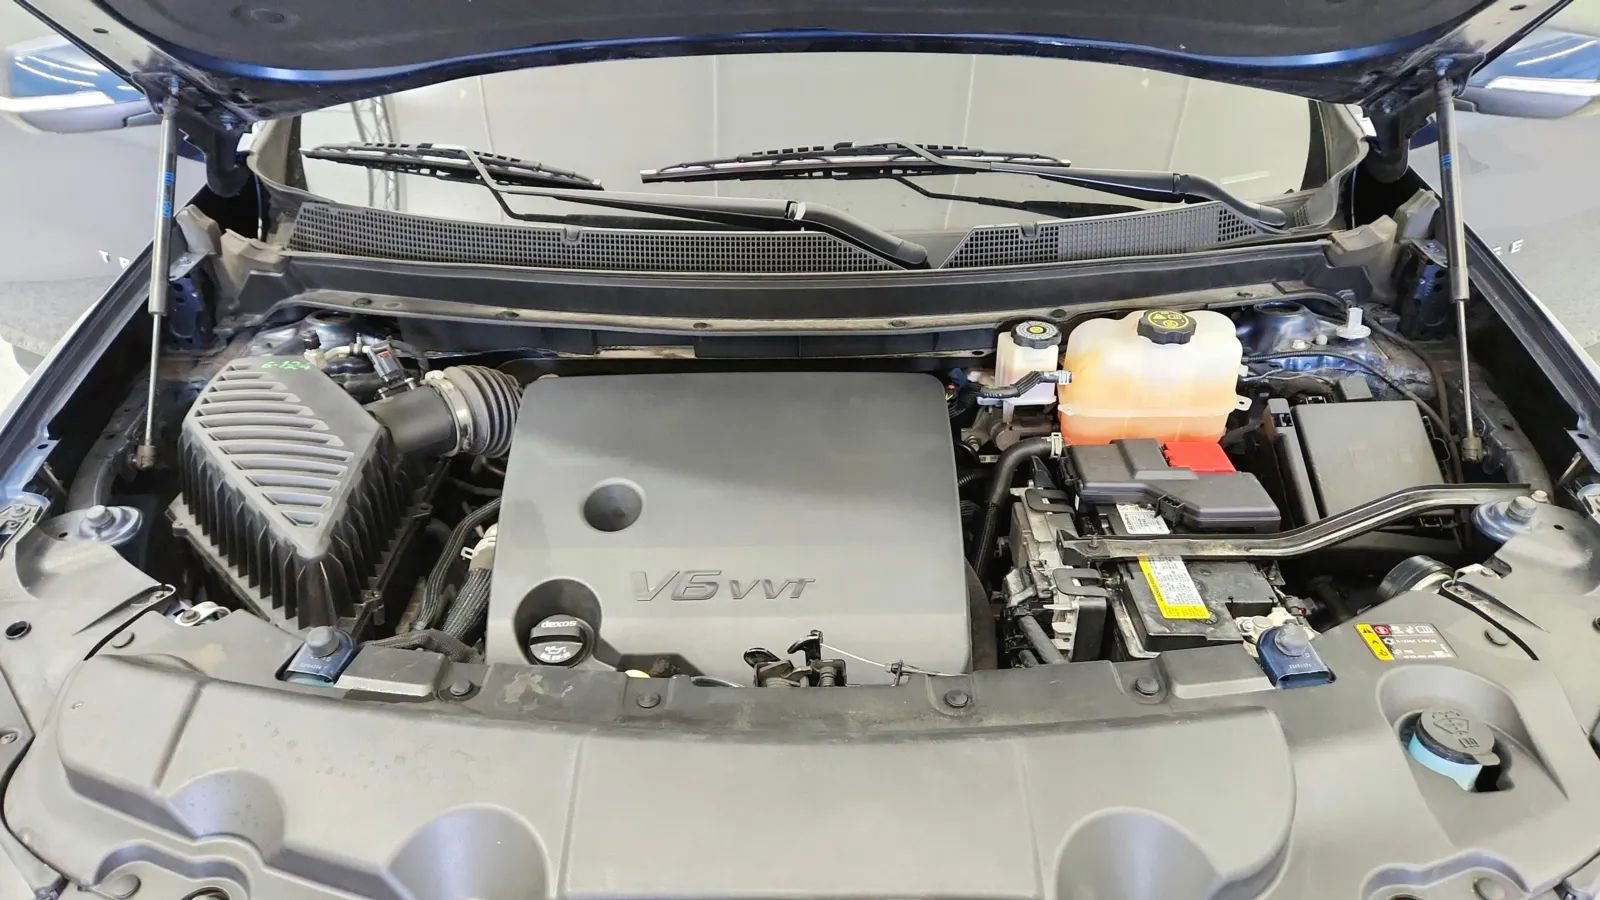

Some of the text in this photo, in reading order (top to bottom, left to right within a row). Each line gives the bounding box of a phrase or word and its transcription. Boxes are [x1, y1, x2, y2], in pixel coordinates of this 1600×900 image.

[630, 569, 817, 602] V6 VVT
[541, 620, 578, 629] dexos
